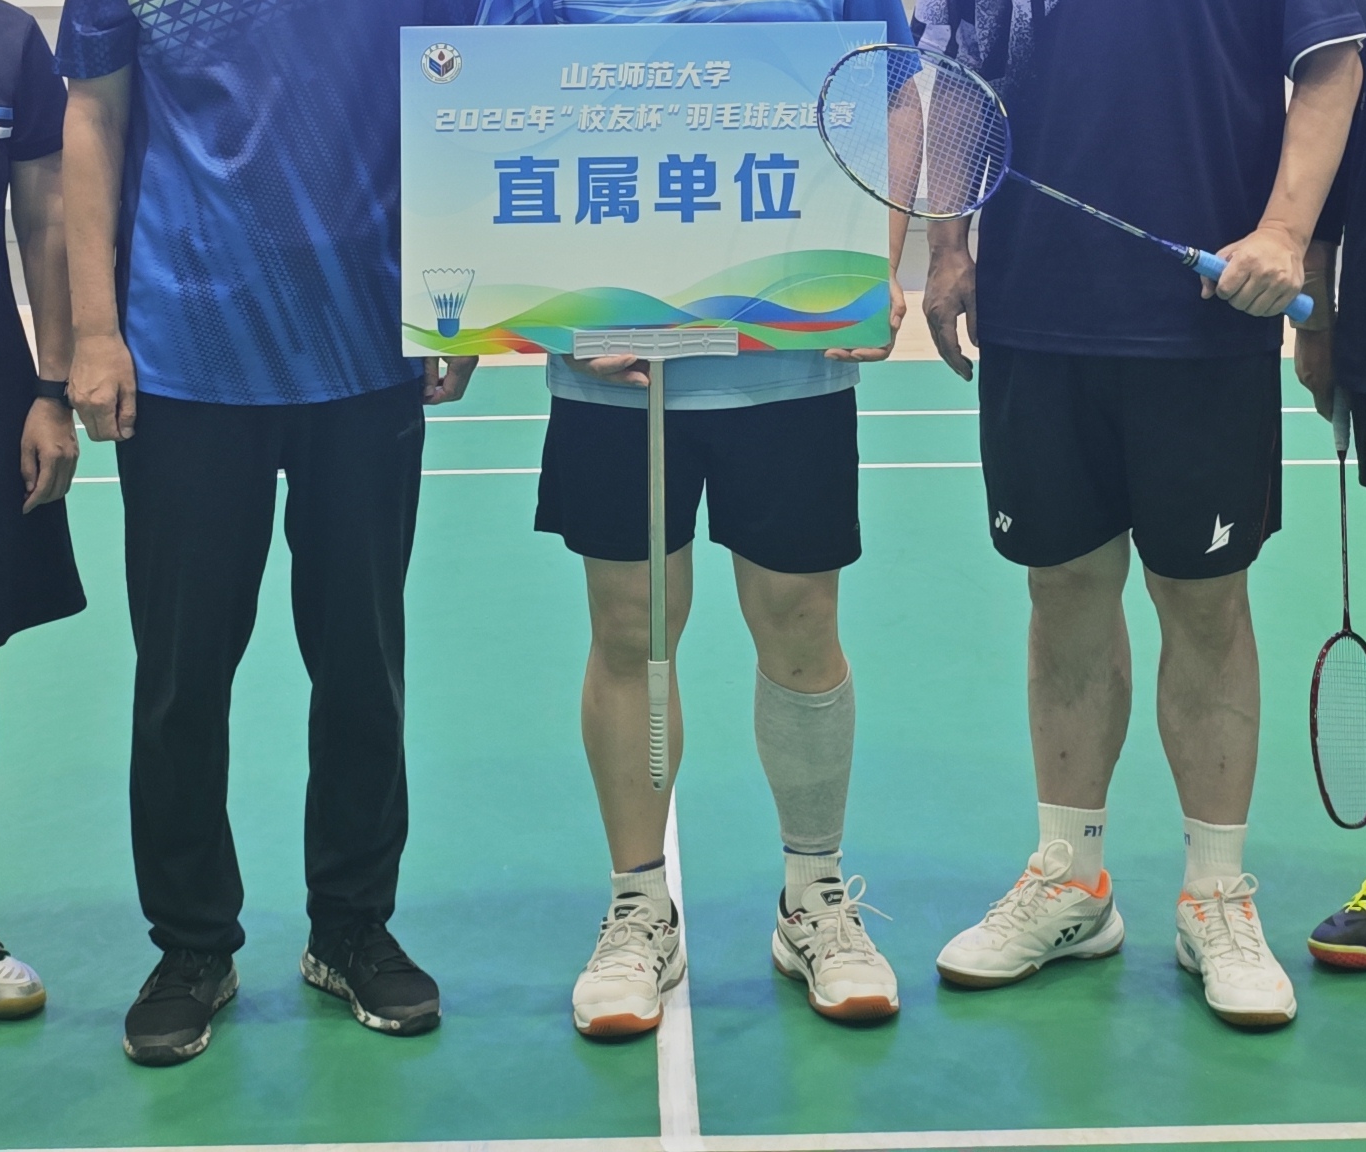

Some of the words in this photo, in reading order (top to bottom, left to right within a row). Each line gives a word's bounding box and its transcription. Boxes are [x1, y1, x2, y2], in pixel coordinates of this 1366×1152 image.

[560, 61, 732, 90] 山东师范大学
[492, 153, 802, 225] 直属单位
